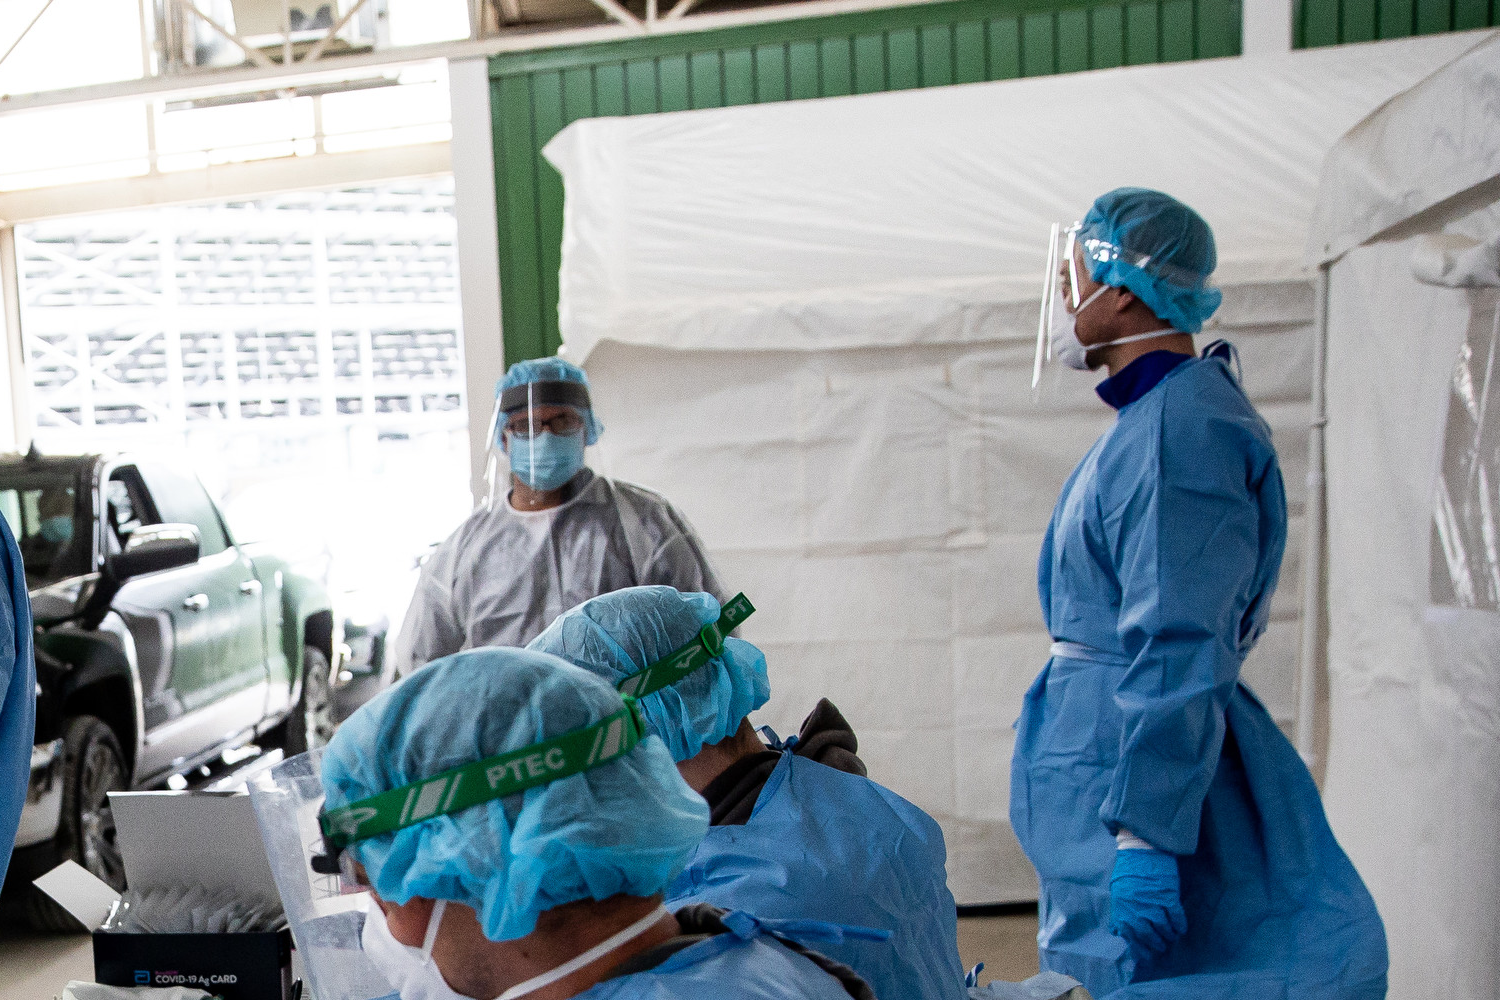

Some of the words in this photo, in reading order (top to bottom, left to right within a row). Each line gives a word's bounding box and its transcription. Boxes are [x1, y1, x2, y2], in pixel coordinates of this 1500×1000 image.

[486, 747, 565, 789] PTEC
[155, 974, 197, 984] COVID-19
[198, 975, 210, 987] Ag
[210, 974, 238, 984] CARD
